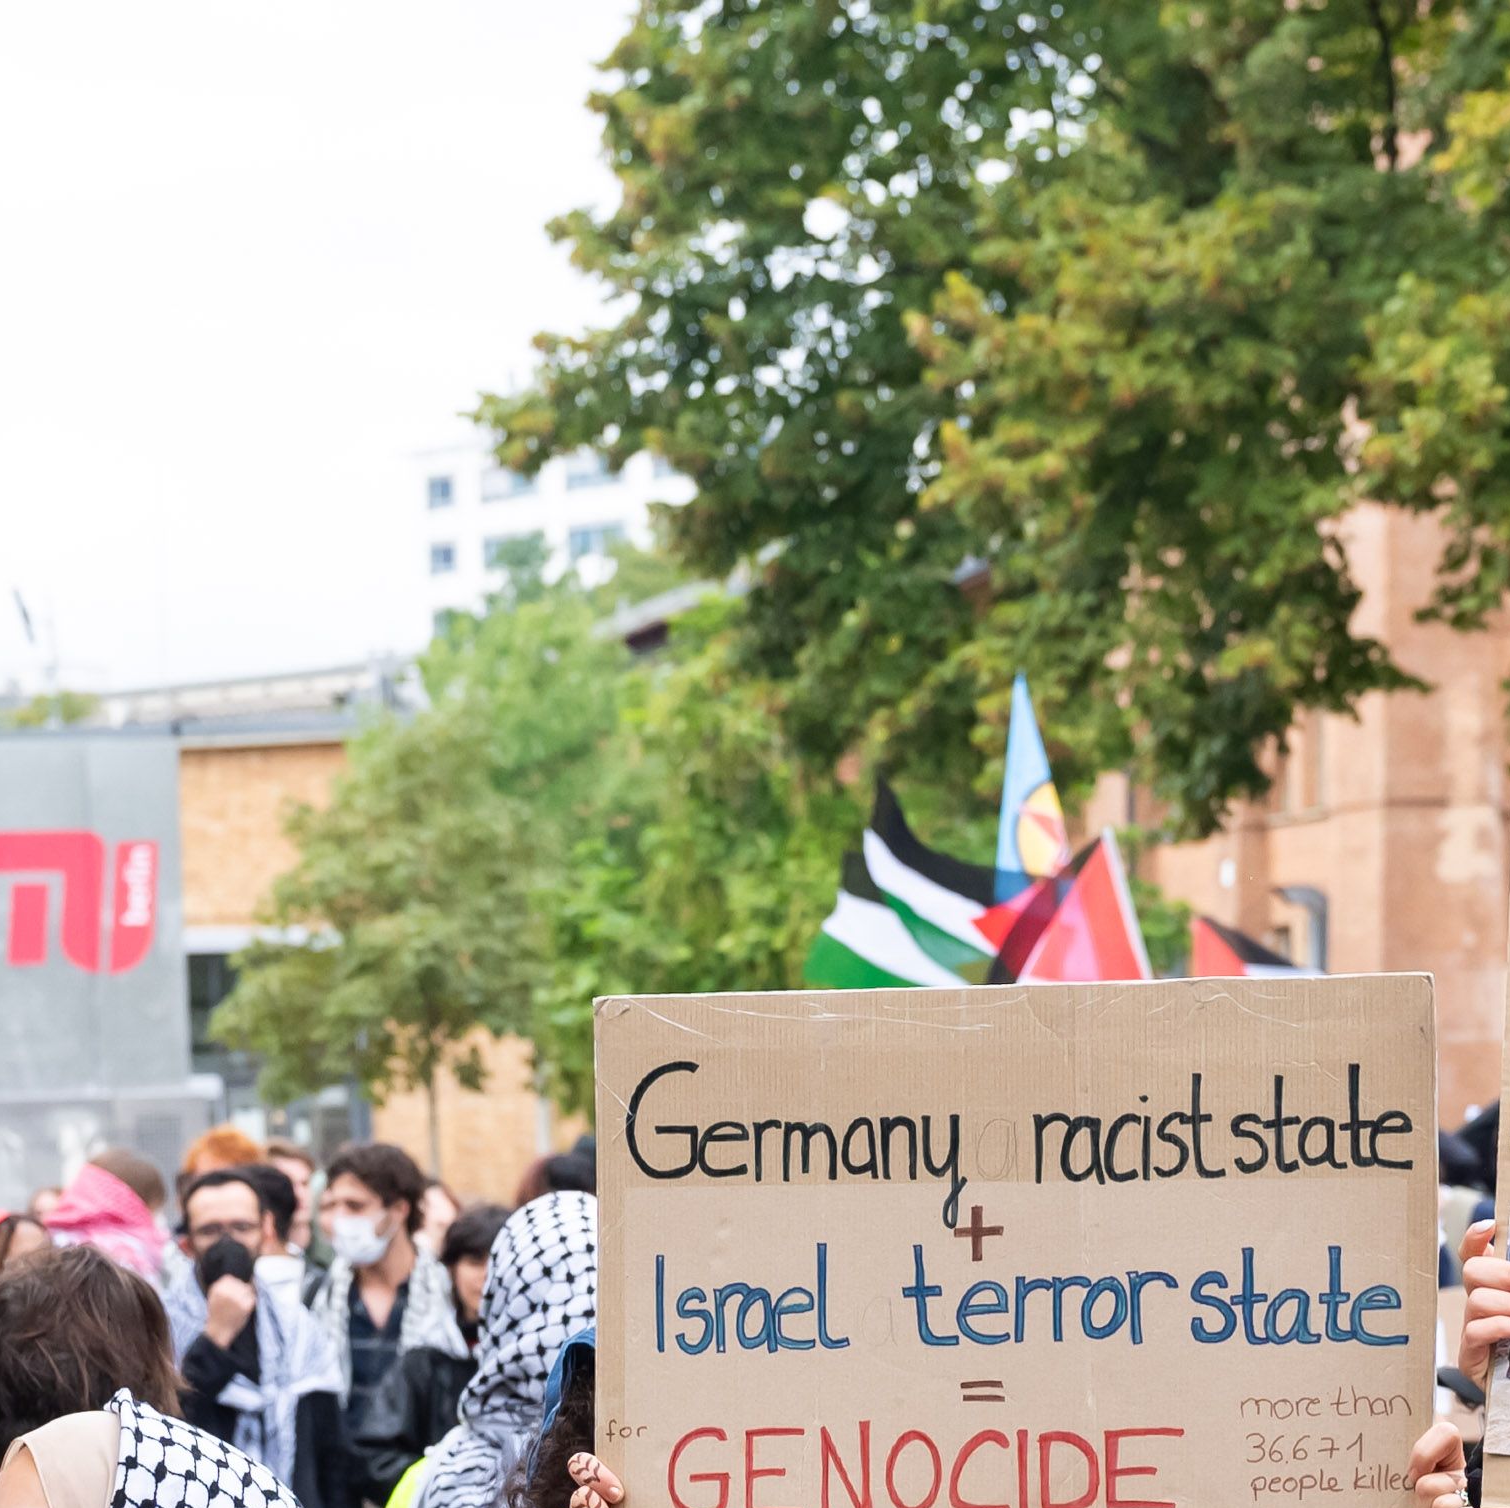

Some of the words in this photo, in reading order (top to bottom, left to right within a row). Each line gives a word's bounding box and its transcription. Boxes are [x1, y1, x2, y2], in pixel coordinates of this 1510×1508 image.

[626, 1061, 968, 1229] Germany
[1033, 1073, 1225, 1185] racist
[1232, 1063, 1413, 1173] state
[655, 1242, 850, 1355] Israel
[902, 1244, 1178, 1346] terror
[1190, 1246, 1409, 1347] state
[1241, 1396, 1321, 1420] more
[1330, 1385, 1412, 1417] than
[606, 1418, 648, 1442] for
[1246, 1432, 1364, 1464] 36.671
[1251, 1468, 1343, 1501] people
